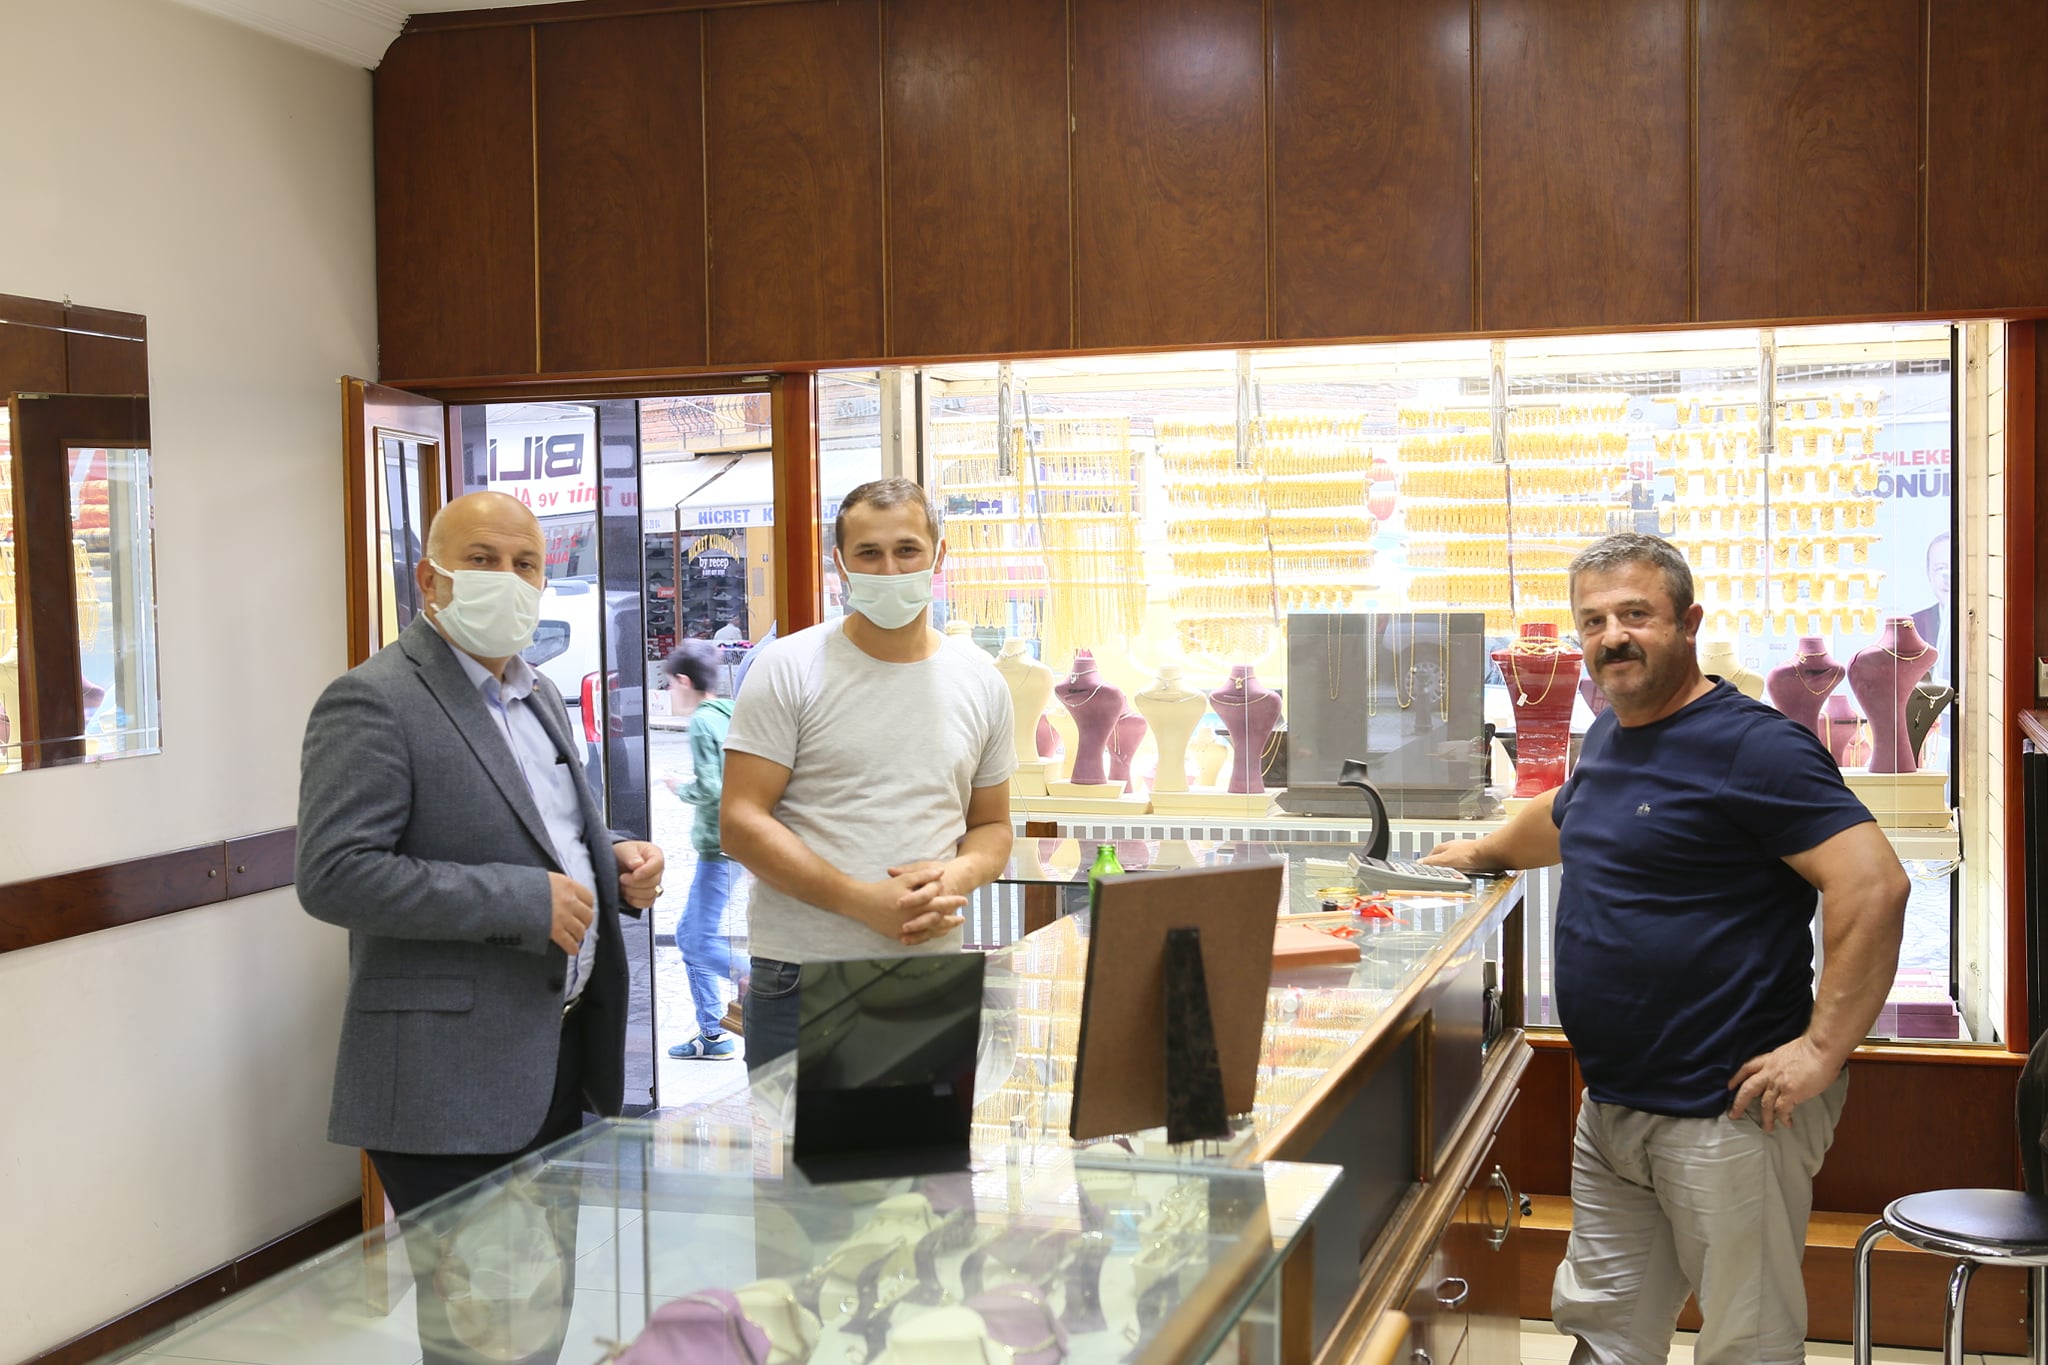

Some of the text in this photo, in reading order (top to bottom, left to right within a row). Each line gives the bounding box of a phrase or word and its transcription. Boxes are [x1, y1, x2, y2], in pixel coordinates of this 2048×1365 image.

[698, 508, 750, 525] HİCRET
[698, 556, 729, 569] by recep
